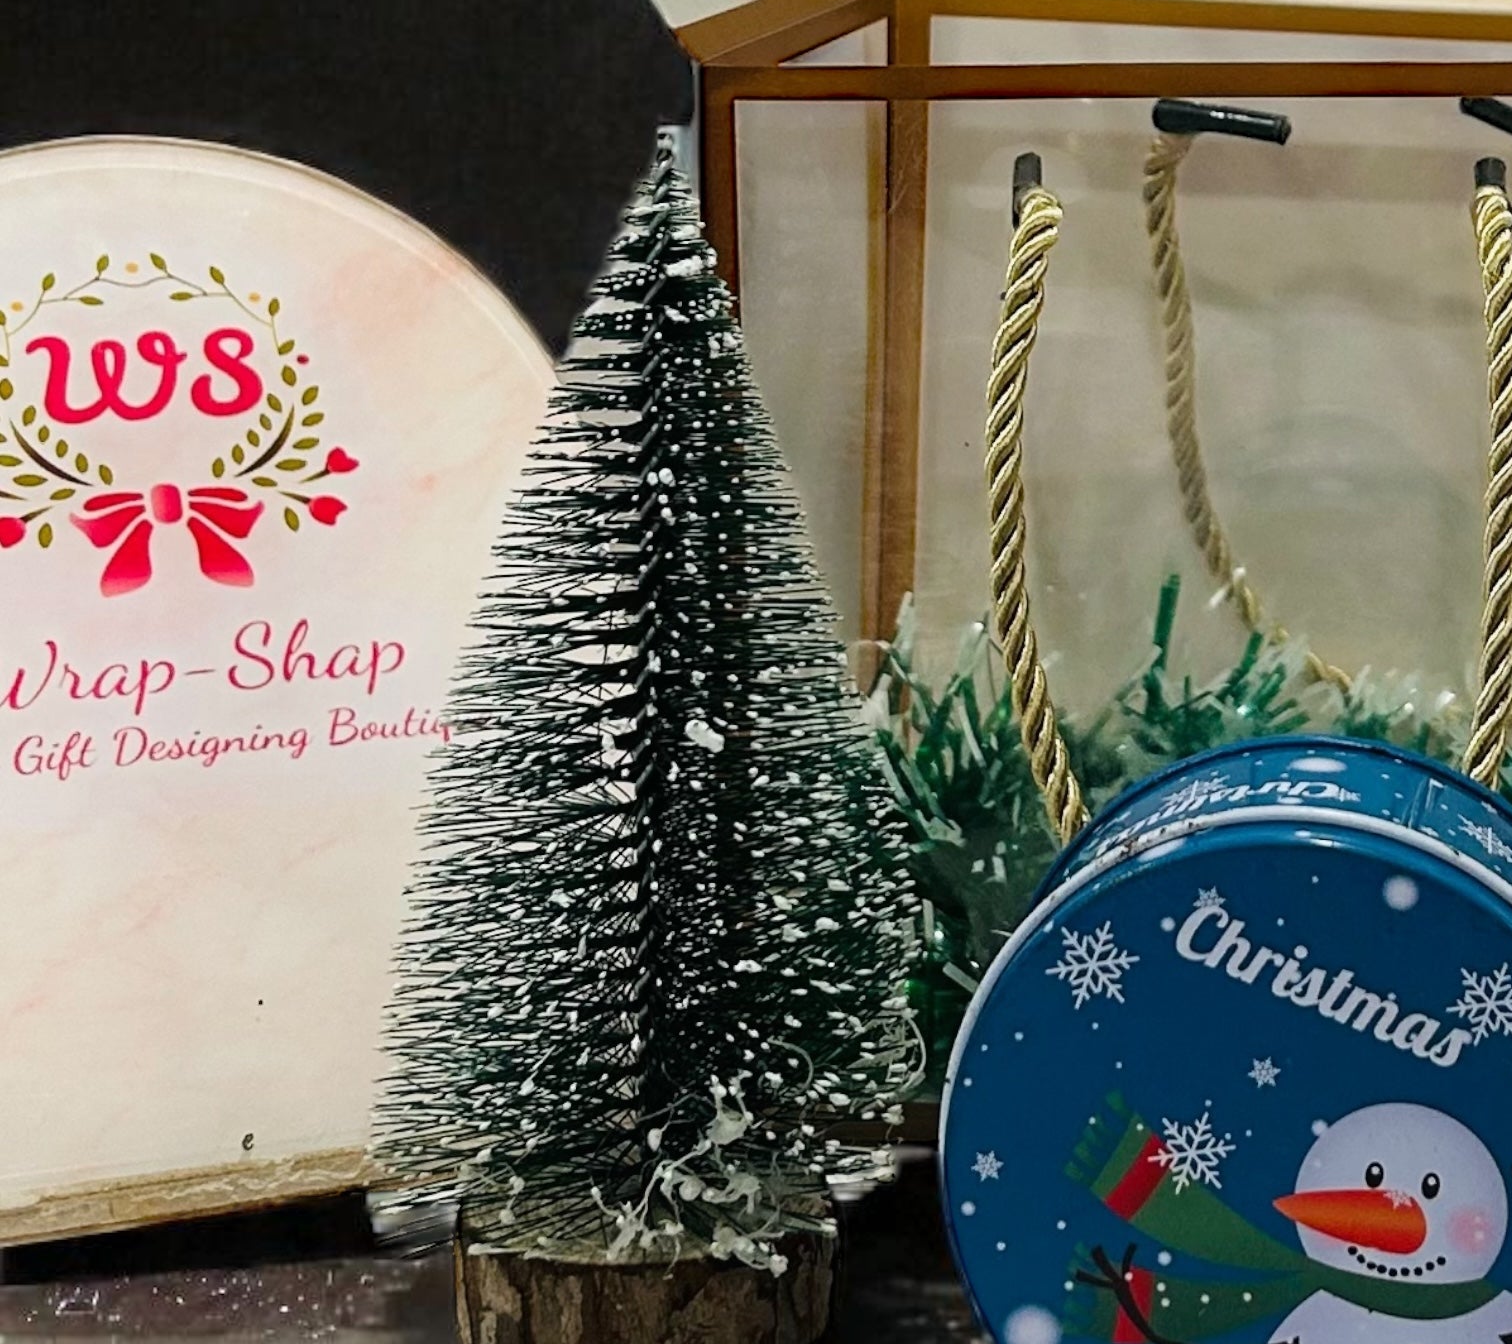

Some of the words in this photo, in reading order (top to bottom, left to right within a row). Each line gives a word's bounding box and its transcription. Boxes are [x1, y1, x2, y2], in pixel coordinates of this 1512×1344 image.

[14, 731, 97, 781] Gift
[113, 724, 310, 768] Designing
[1175, 901, 1473, 1068] Christmas
